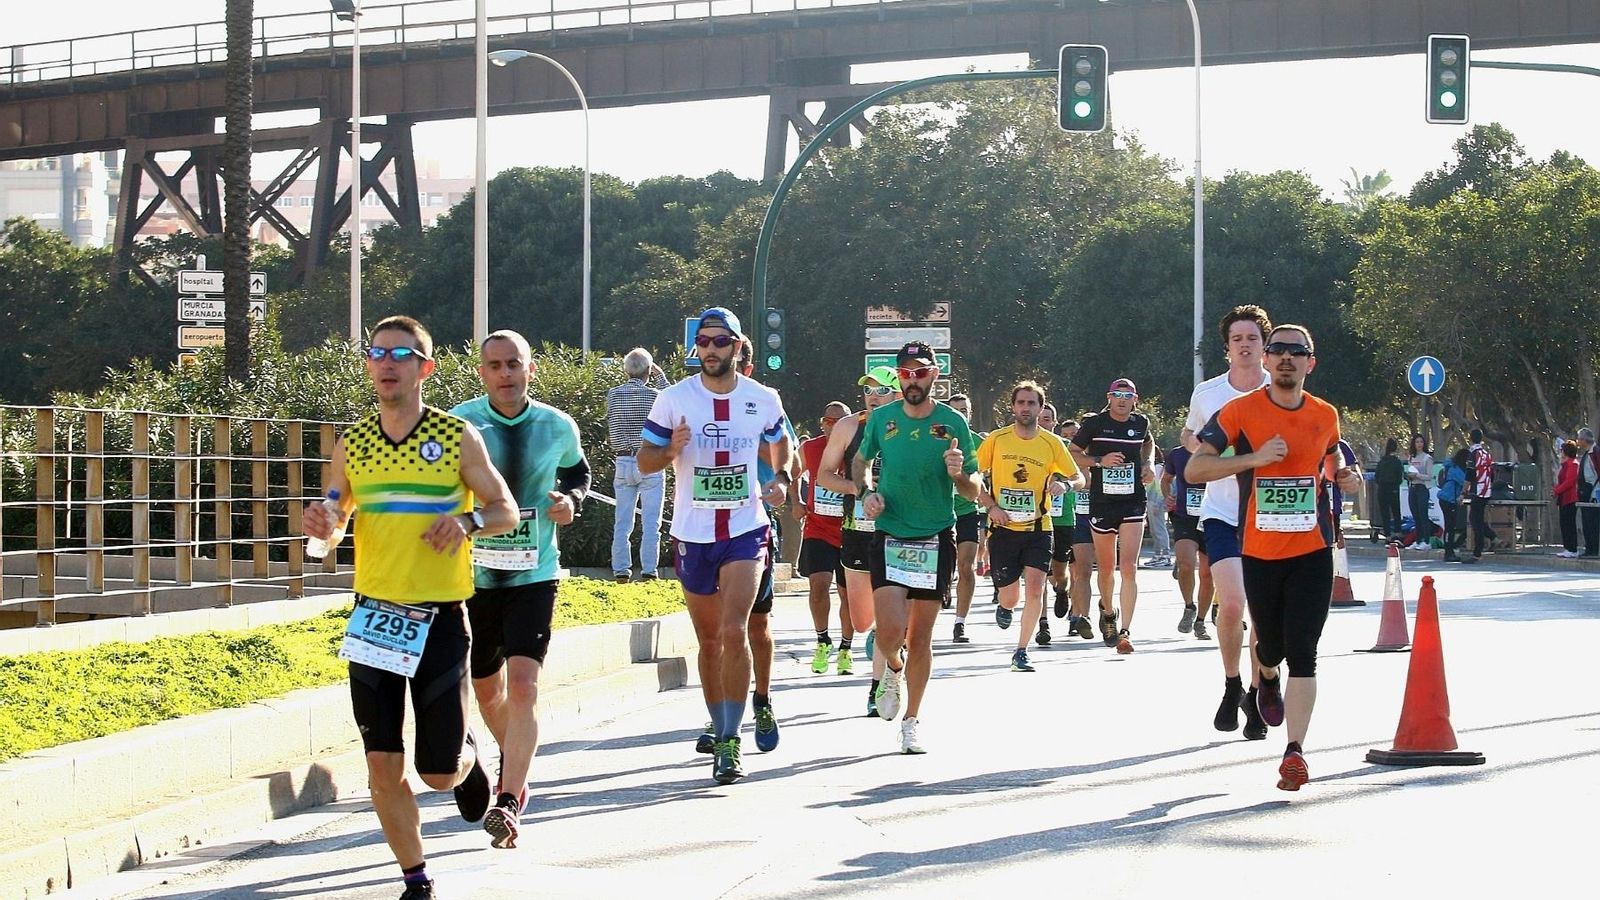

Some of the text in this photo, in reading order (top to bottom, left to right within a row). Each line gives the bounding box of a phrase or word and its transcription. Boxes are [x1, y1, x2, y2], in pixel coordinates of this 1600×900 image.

[184, 334, 223, 342] aeropuerto
[1107, 470, 1132, 479] 2308
[701, 475, 744, 491] 1485
[1004, 495, 1031, 506] 1914
[1264, 488, 1309, 504] 2597
[897, 549, 928, 564] 420
[364, 611, 420, 641] 1295
[363, 629, 382, 639] DAVID
